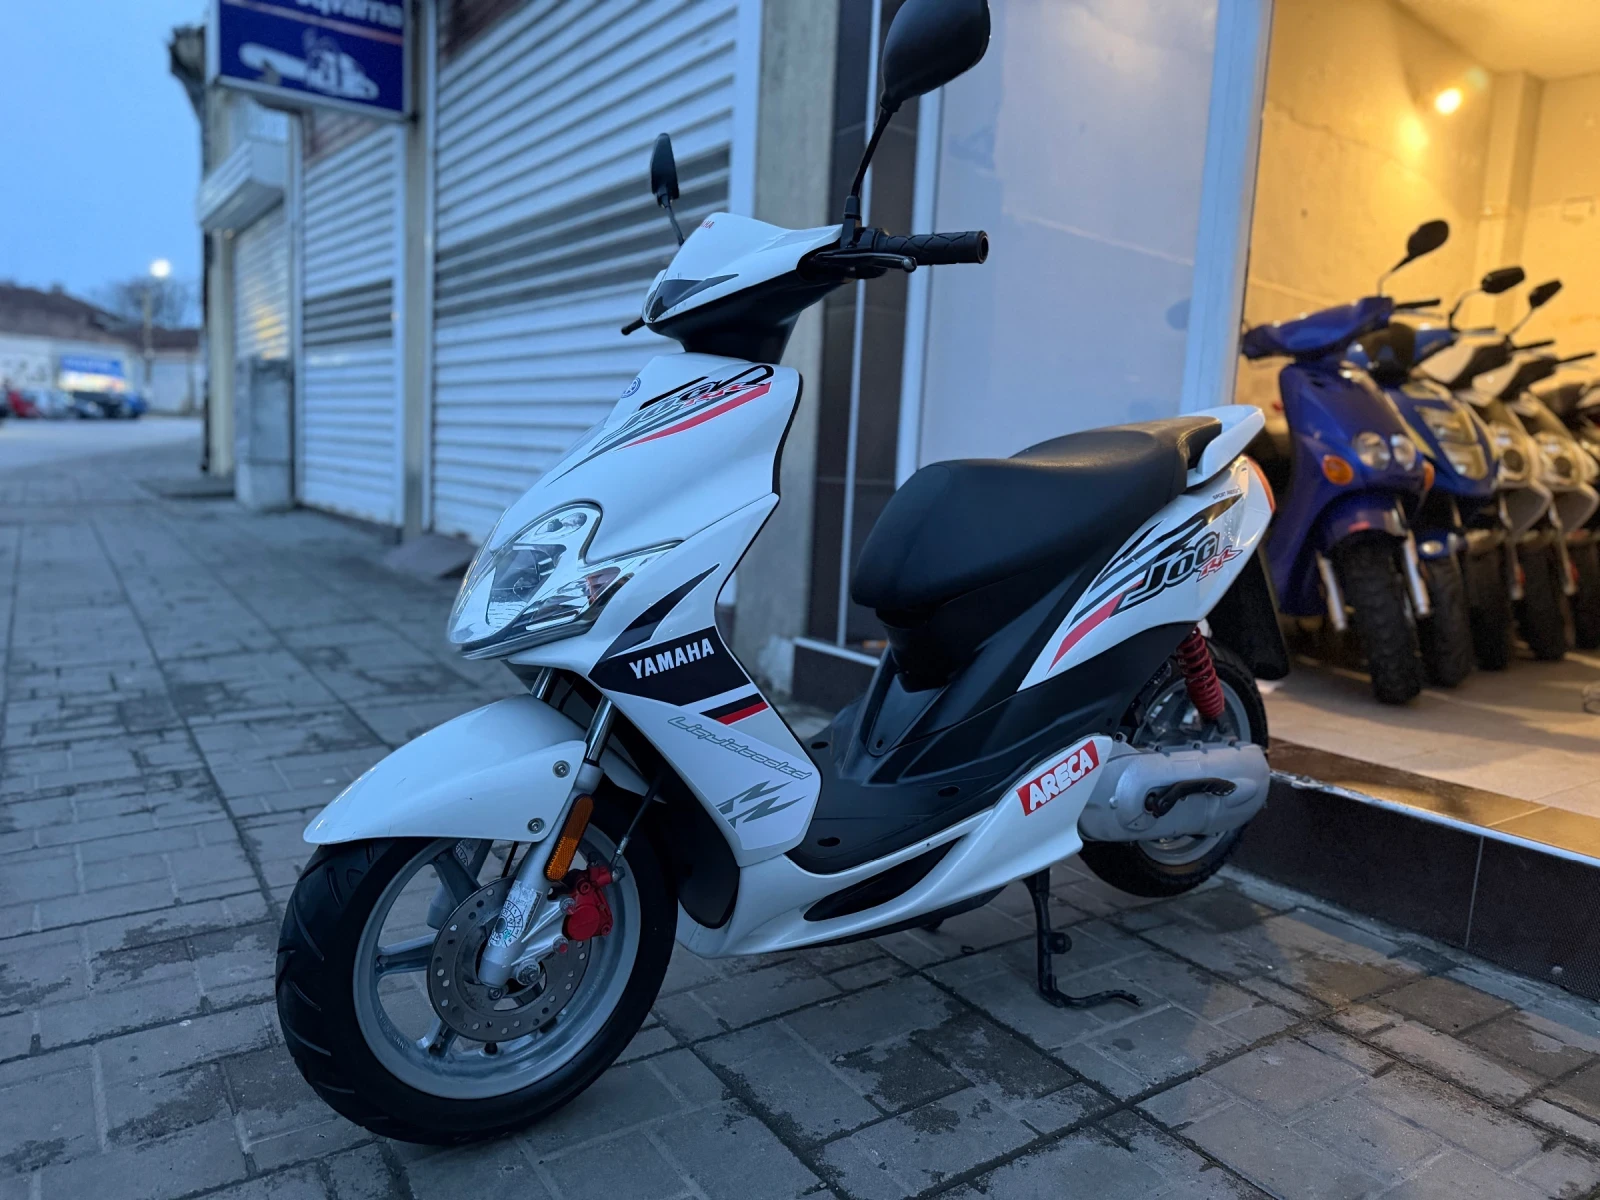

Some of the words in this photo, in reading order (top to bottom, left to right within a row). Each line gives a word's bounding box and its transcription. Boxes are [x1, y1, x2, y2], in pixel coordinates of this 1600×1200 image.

[1109, 532, 1220, 618] JOG
[629, 637, 715, 680] YAMAHA
[1029, 748, 1094, 811] ARECA
